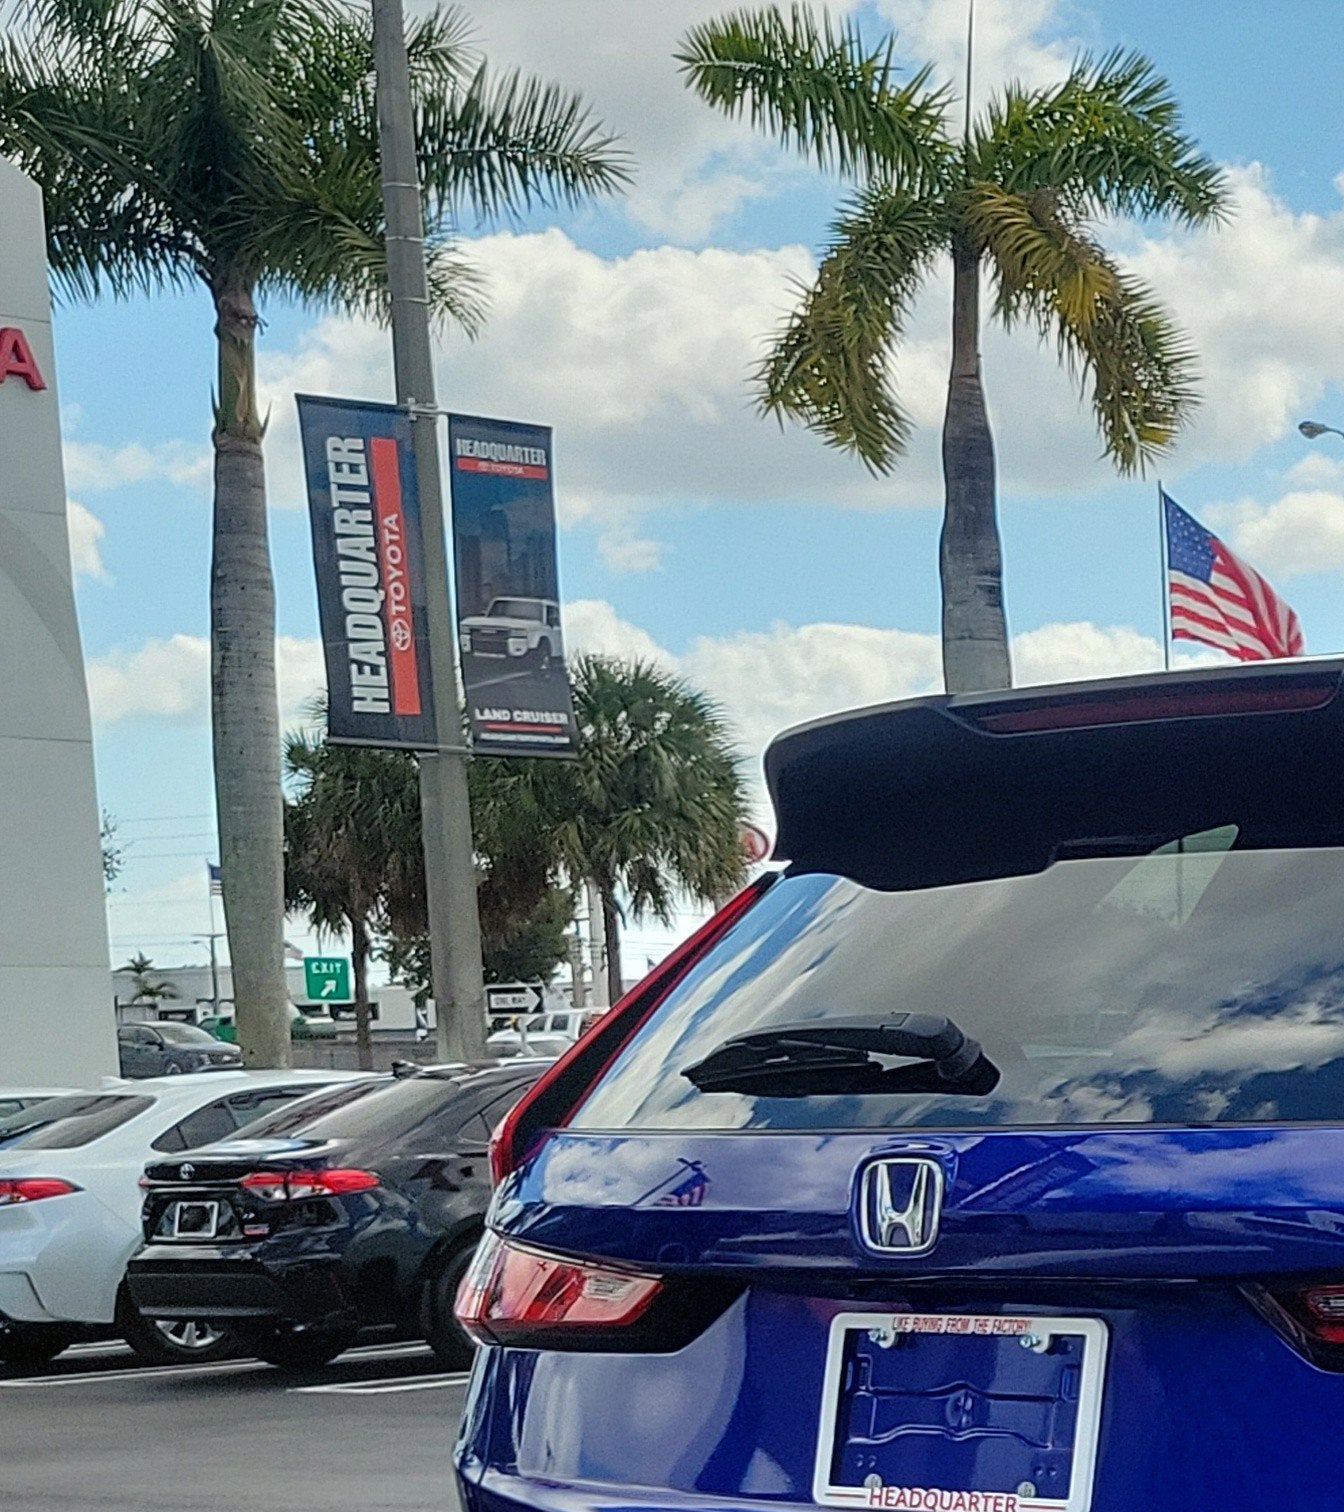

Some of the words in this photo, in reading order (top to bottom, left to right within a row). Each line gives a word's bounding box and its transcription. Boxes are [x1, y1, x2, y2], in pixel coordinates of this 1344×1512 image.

[456, 438, 546, 466] HEADQUARTER
[326, 435, 391, 714] HEADQUARTER
[382, 513, 408, 615] TOYOTA
[474, 708, 511, 721] LAND
[513, 710, 569, 725] CRUISER
[311, 961, 342, 975] EXIT
[946, 1317, 971, 1333] FROM
[973, 1318, 990, 1332] THE
